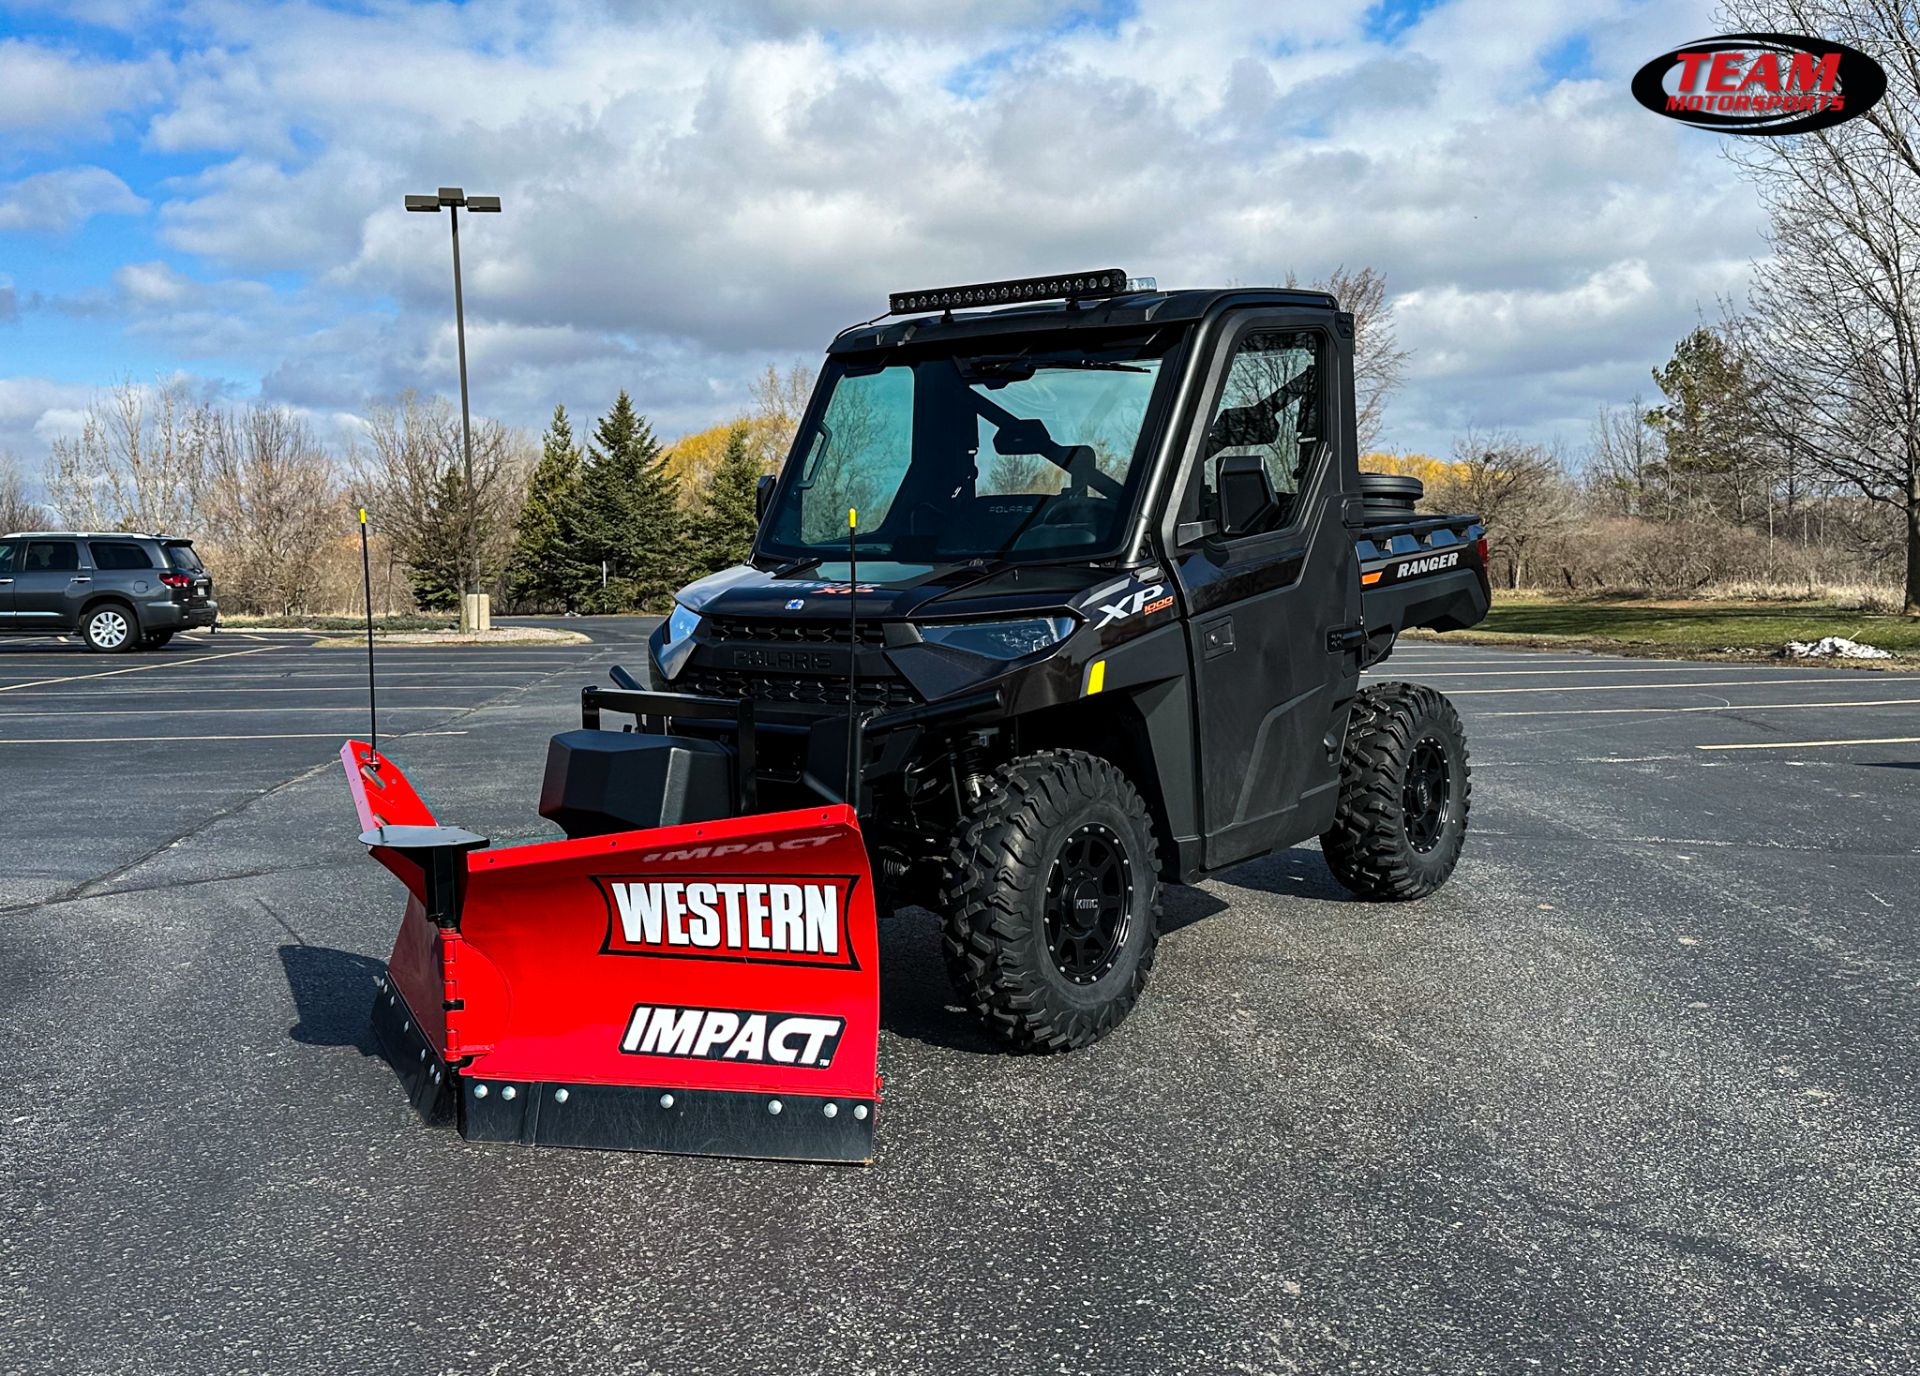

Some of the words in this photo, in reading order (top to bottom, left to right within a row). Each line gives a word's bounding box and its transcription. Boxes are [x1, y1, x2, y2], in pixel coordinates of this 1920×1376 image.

[1397, 552, 1459, 578] RANGER
[1093, 584, 1164, 631] XP
[1144, 596, 1174, 614] 1000
[733, 650, 832, 670] POLARIS
[611, 882, 838, 955] WESTERN
[622, 1006, 841, 1065] IMPACT
